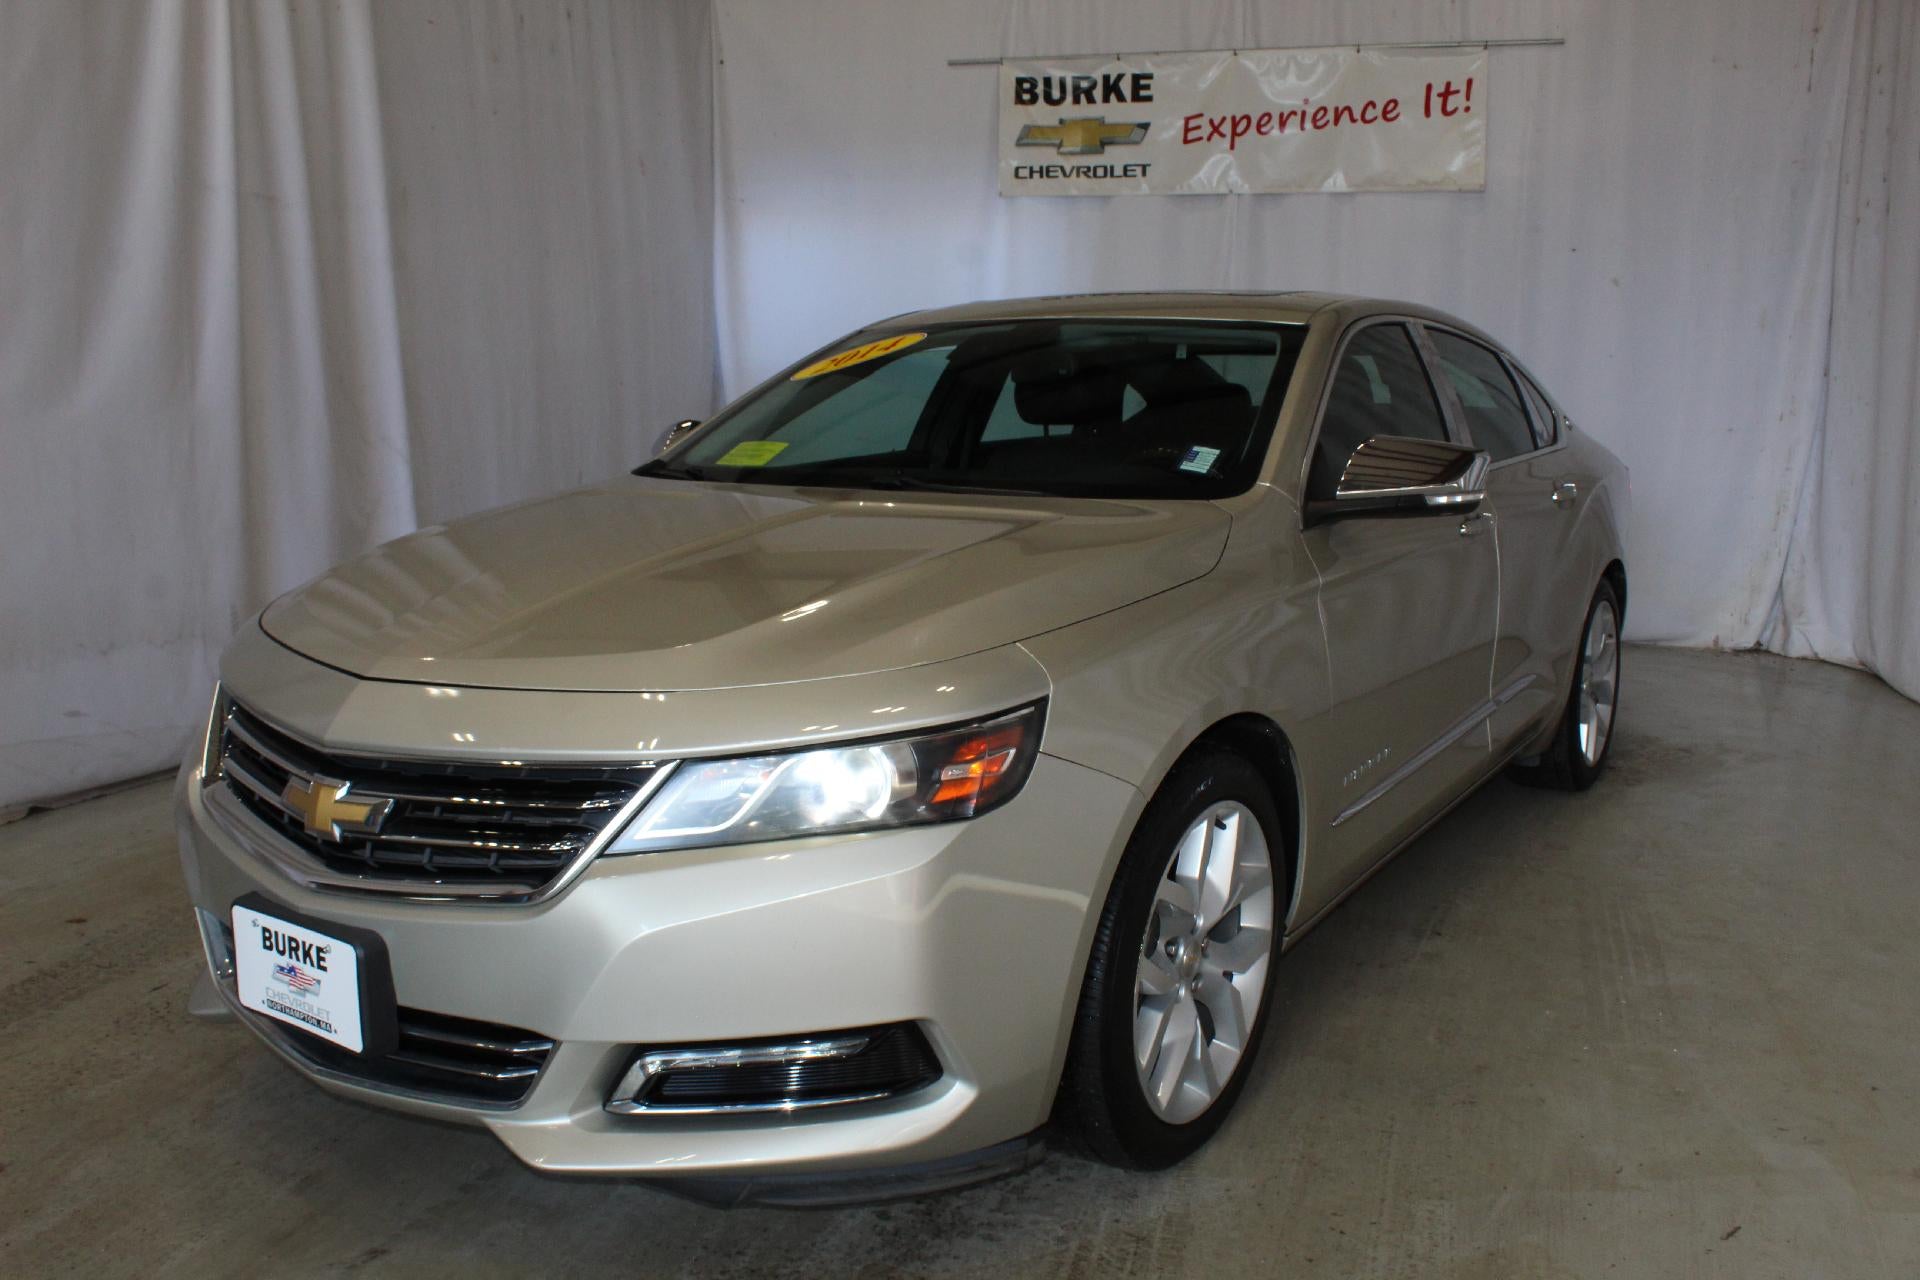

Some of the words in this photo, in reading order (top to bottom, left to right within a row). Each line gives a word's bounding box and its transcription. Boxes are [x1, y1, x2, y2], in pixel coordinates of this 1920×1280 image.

[1014, 73, 1154, 106] BURKE
[1181, 98, 1400, 151] Experience
[1422, 77, 1474, 119] It!
[1014, 163, 1151, 180] CHEVROLET
[261, 926, 328, 972] BURKE
[265, 986, 331, 1022] CHEVROLET
